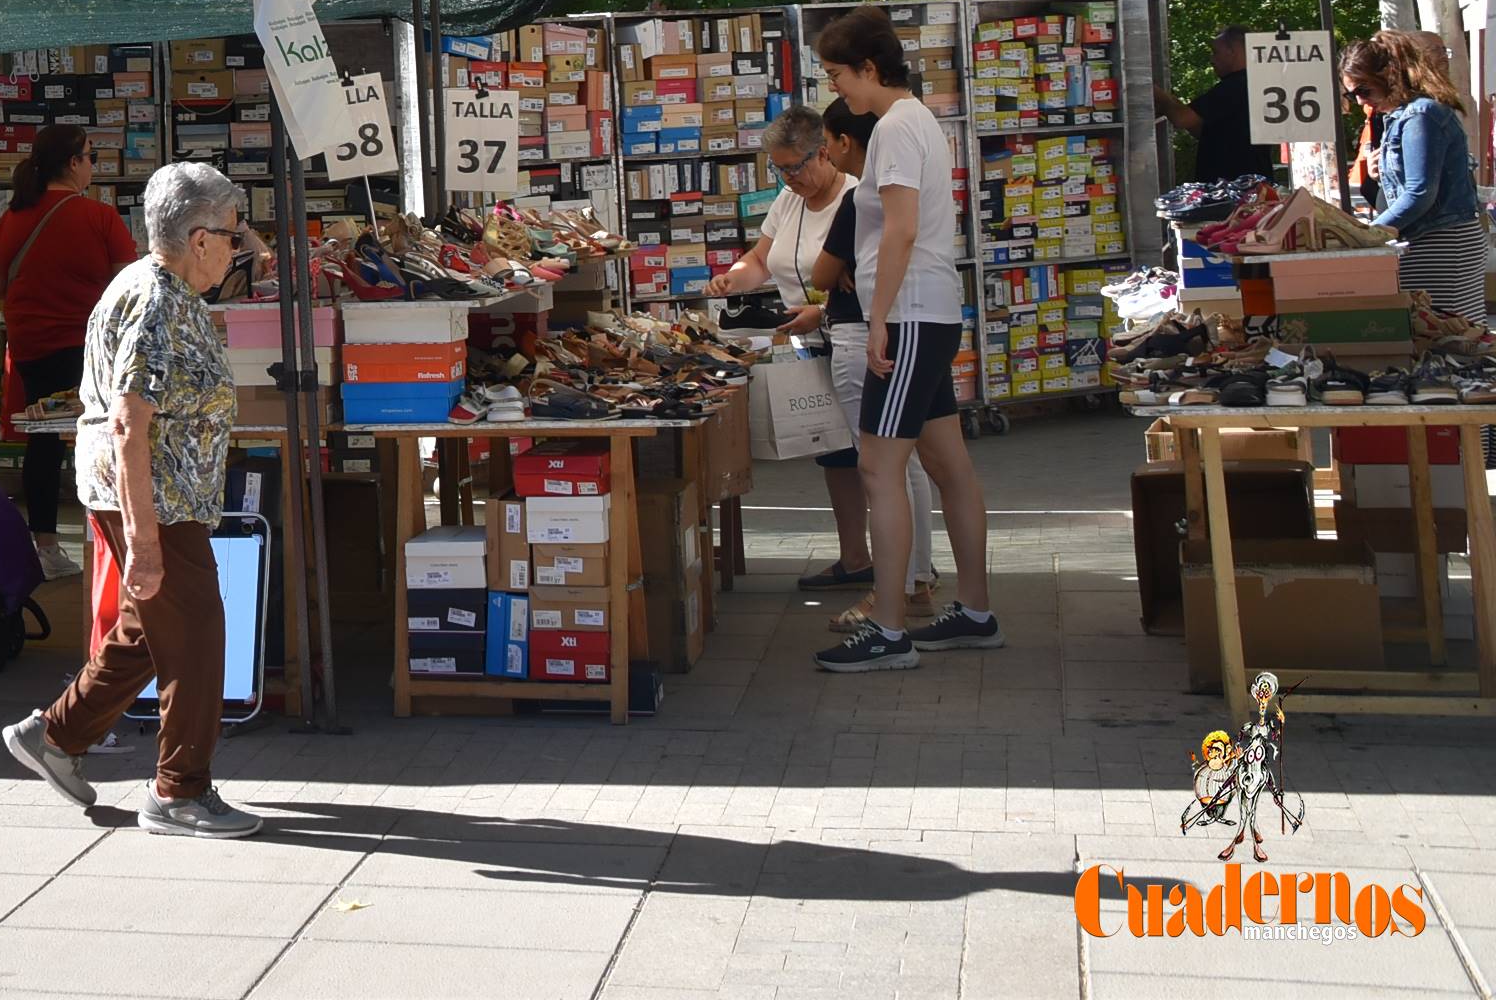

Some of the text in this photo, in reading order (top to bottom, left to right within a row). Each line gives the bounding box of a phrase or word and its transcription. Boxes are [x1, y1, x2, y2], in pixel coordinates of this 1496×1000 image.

[1252, 44, 1325, 64] TALLA
[345, 85, 380, 105] LLA
[1262, 85, 1321, 125] 36
[451, 101, 514, 119] TALLA
[456, 139, 507, 174] 37
[789, 392, 833, 412] ROSES
